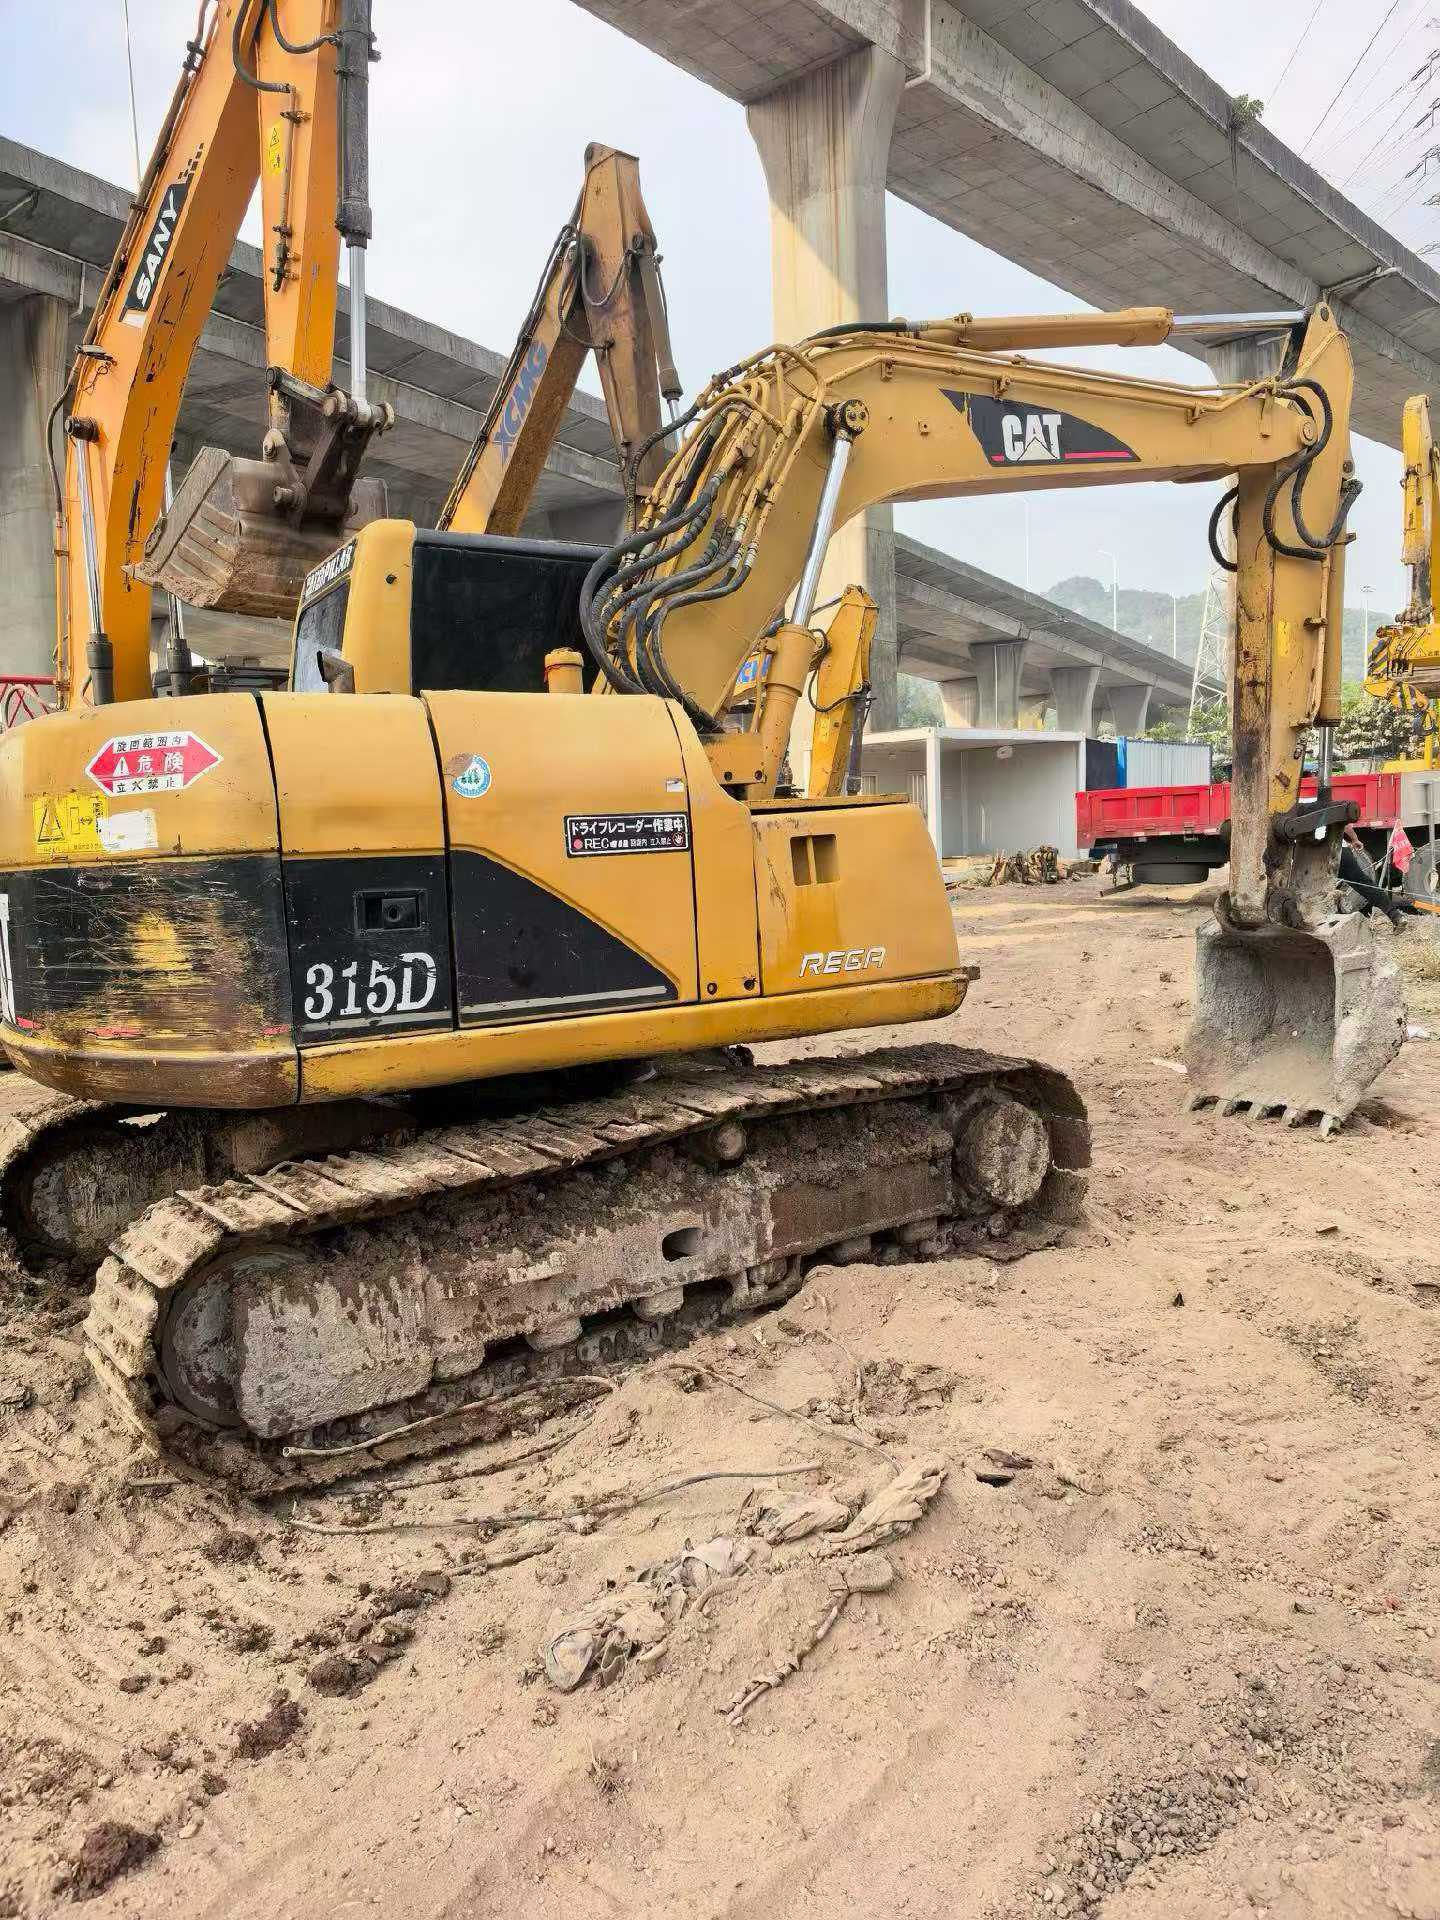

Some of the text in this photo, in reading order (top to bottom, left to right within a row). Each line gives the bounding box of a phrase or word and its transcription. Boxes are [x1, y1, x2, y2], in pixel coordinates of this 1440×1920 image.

[136, 189, 178, 308] SANY
[493, 341, 548, 464] XCMG
[1001, 414, 1062, 461] CAT
[137, 752, 185, 774] 危険
[584, 837, 610, 850] REC
[799, 946, 887, 977] REGA
[304, 952, 437, 1019] 315D
